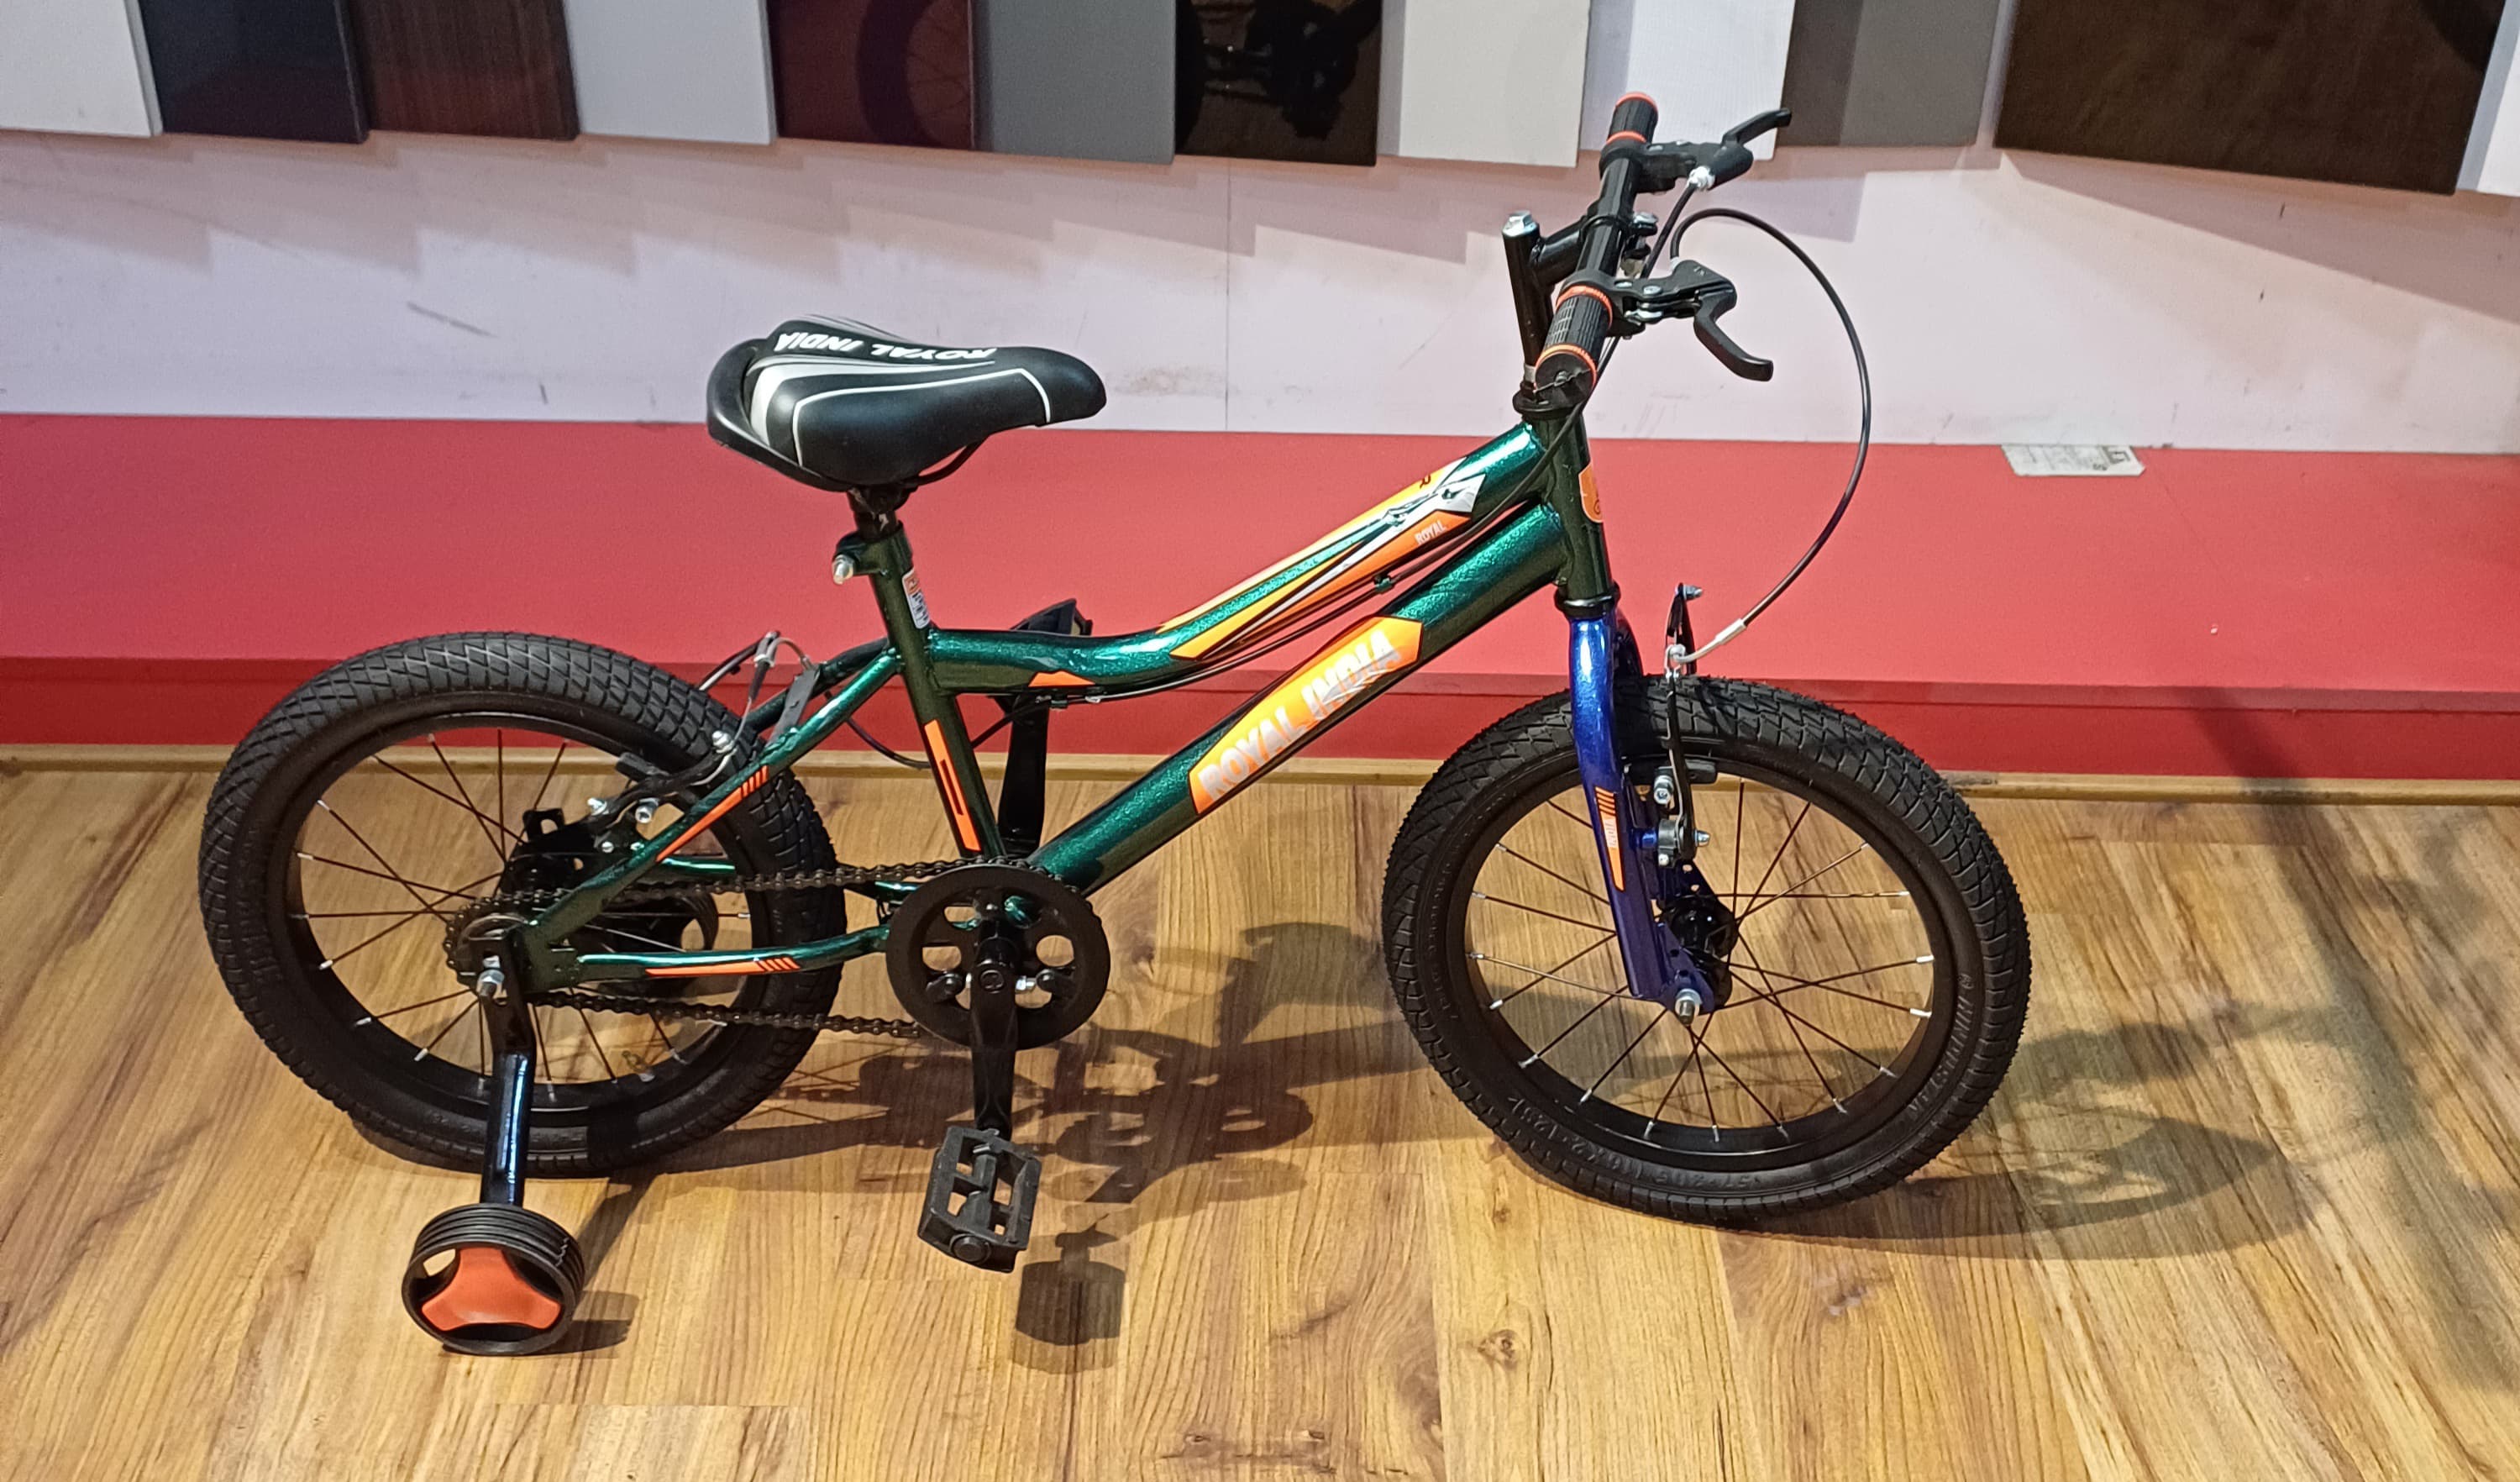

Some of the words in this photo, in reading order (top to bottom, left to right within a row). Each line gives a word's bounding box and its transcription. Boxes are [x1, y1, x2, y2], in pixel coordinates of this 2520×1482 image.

[773, 331, 865, 352] INDIA
[870, 343, 998, 360] ROYAL
[1415, 519, 1448, 546] ROYAL
[1197, 705, 1308, 802] ROYAL
[1301, 628, 1402, 721] INDIA
